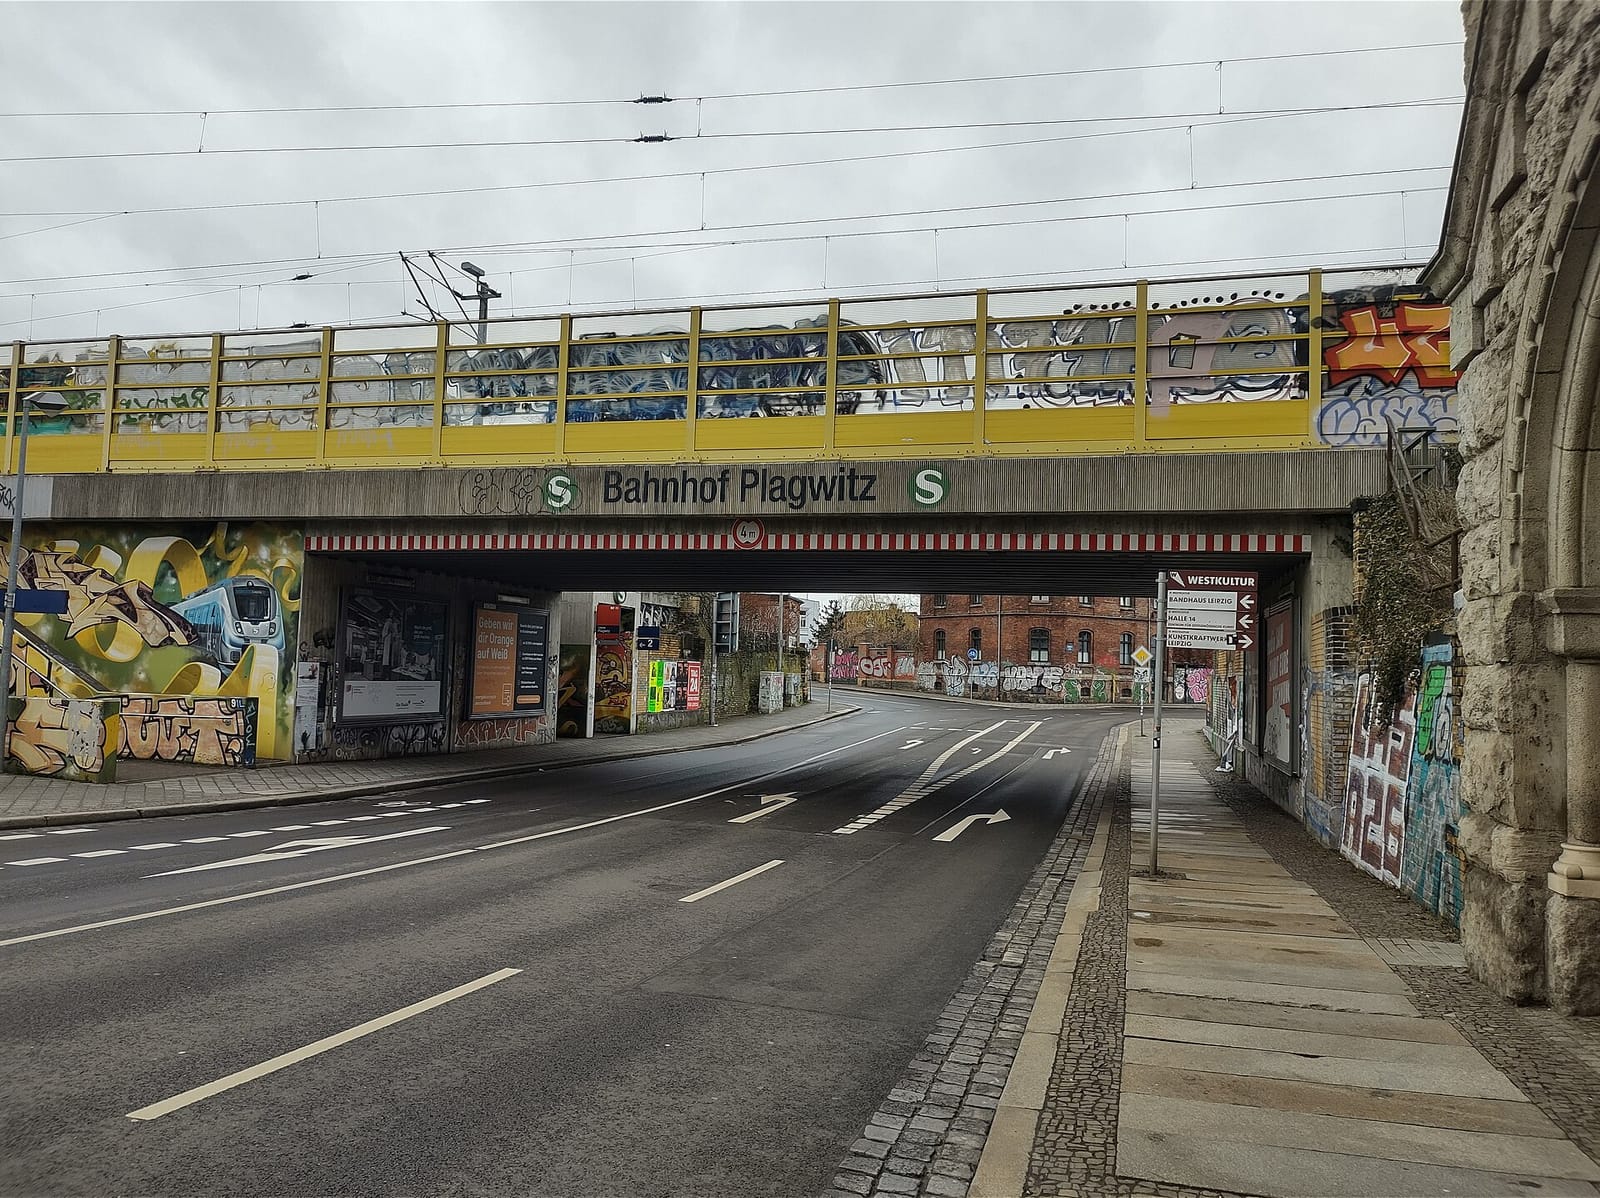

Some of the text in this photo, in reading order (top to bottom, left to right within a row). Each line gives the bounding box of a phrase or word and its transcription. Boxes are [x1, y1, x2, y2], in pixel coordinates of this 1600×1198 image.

[548, 476, 572, 507] S
[603, 469, 730, 503] Bahnhof
[740, 466, 878, 510] Plagwitz
[915, 469, 944, 504] S
[741, 526, 747, 538] 4
[1187, 576, 1255, 586] WESTKULTUR
[1169, 596, 1233, 605] BANDHAUS LEIPZIG
[479, 617, 501, 629] Geben
[502, 619, 513, 630] wir
[478, 632, 514, 647] dir Orange
[647, 639, 653, 648] 2
[477, 648, 508, 660] auf Weiß
[690, 677, 698, 692] 24
